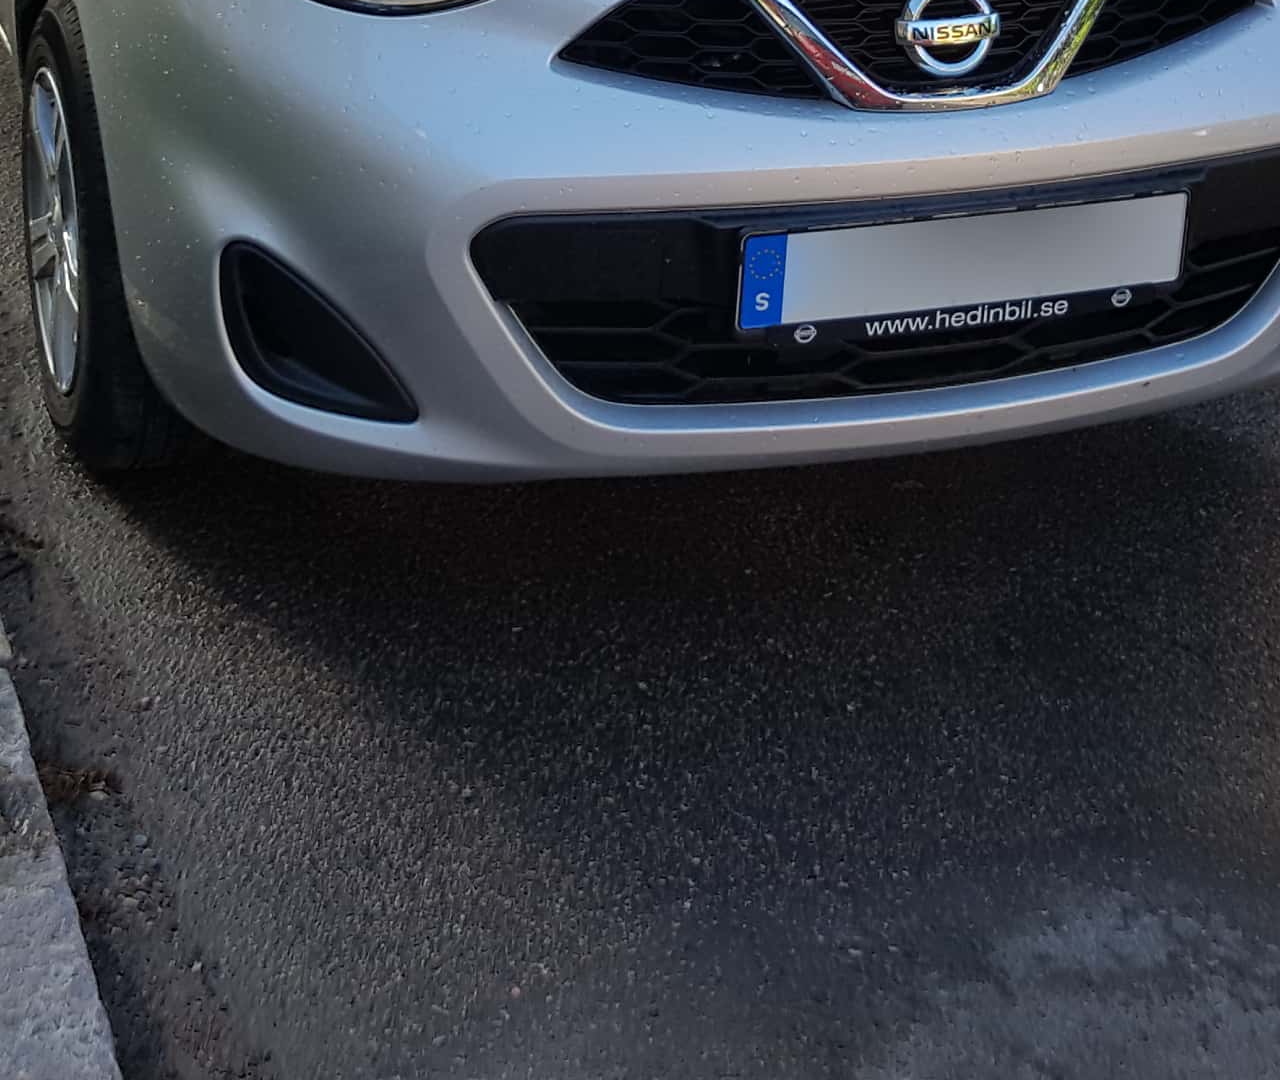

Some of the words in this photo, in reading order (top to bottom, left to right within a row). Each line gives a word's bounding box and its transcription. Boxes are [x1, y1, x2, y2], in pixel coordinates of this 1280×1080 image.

[912, 19, 992, 41] NISSAN
[755, 292, 770, 311] S
[865, 299, 1069, 336] www.hedinbil.se
